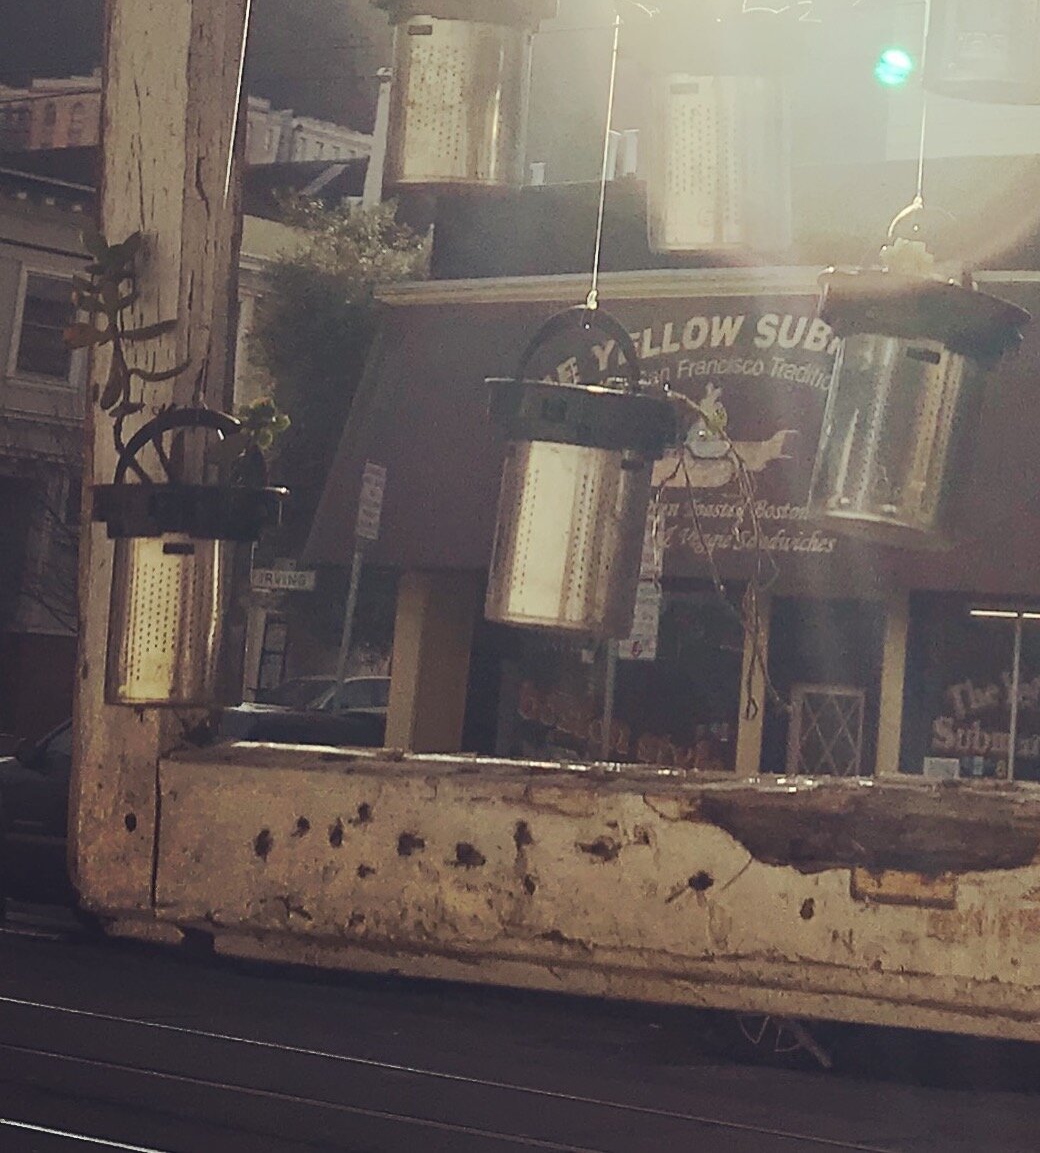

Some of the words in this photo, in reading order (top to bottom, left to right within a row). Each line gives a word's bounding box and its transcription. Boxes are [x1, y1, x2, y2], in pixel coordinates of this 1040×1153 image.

[676, 357, 765, 379] Francisco
[769, 357, 831, 391] Traditio
[259, 572, 307, 586] IRVING
